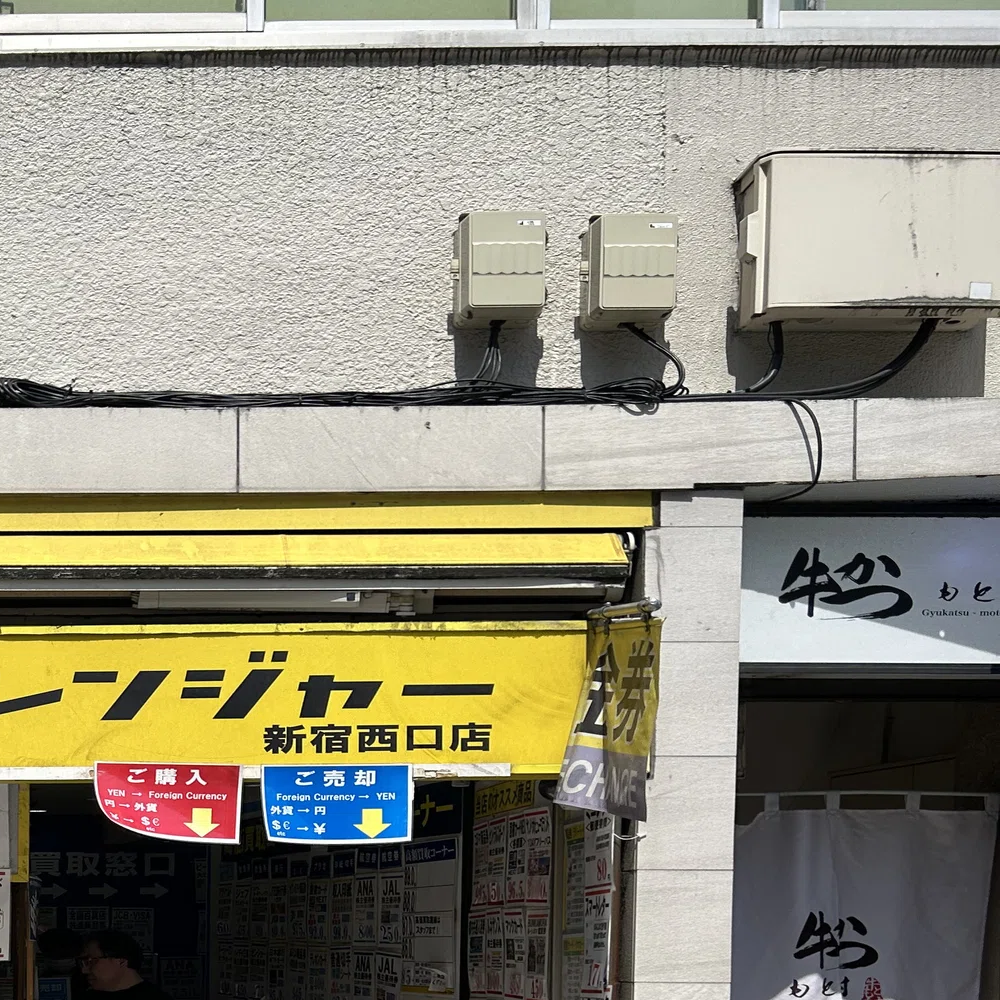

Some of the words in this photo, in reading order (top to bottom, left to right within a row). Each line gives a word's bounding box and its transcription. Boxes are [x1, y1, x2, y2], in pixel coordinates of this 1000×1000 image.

[778, 547, 913, 621] 牛かつ
[922, 609, 969, 618] Gyukatsu
[263, 723, 492, 754] 新宿西口店
[127, 768, 207, 786] ご購入
[295, 769, 376, 787] ご売却
[107, 789, 126, 797] YEN
[149, 790, 183, 800] Foreign
[186, 791, 227, 801] Currency
[276, 793, 310, 802] Foreign
[314, 793, 355, 802] Currency
[376, 792, 396, 800] YEN
[104, 799, 115, 808] 円
[134, 802, 158, 813] 外貨
[270, 805, 293, 815] 外貨
[314, 806, 326, 815] 円
[357, 880, 374, 896] ANA
[383, 879, 400, 896] JAL
[355, 956, 371, 972] ANA
[378, 957, 397, 975] JAL
